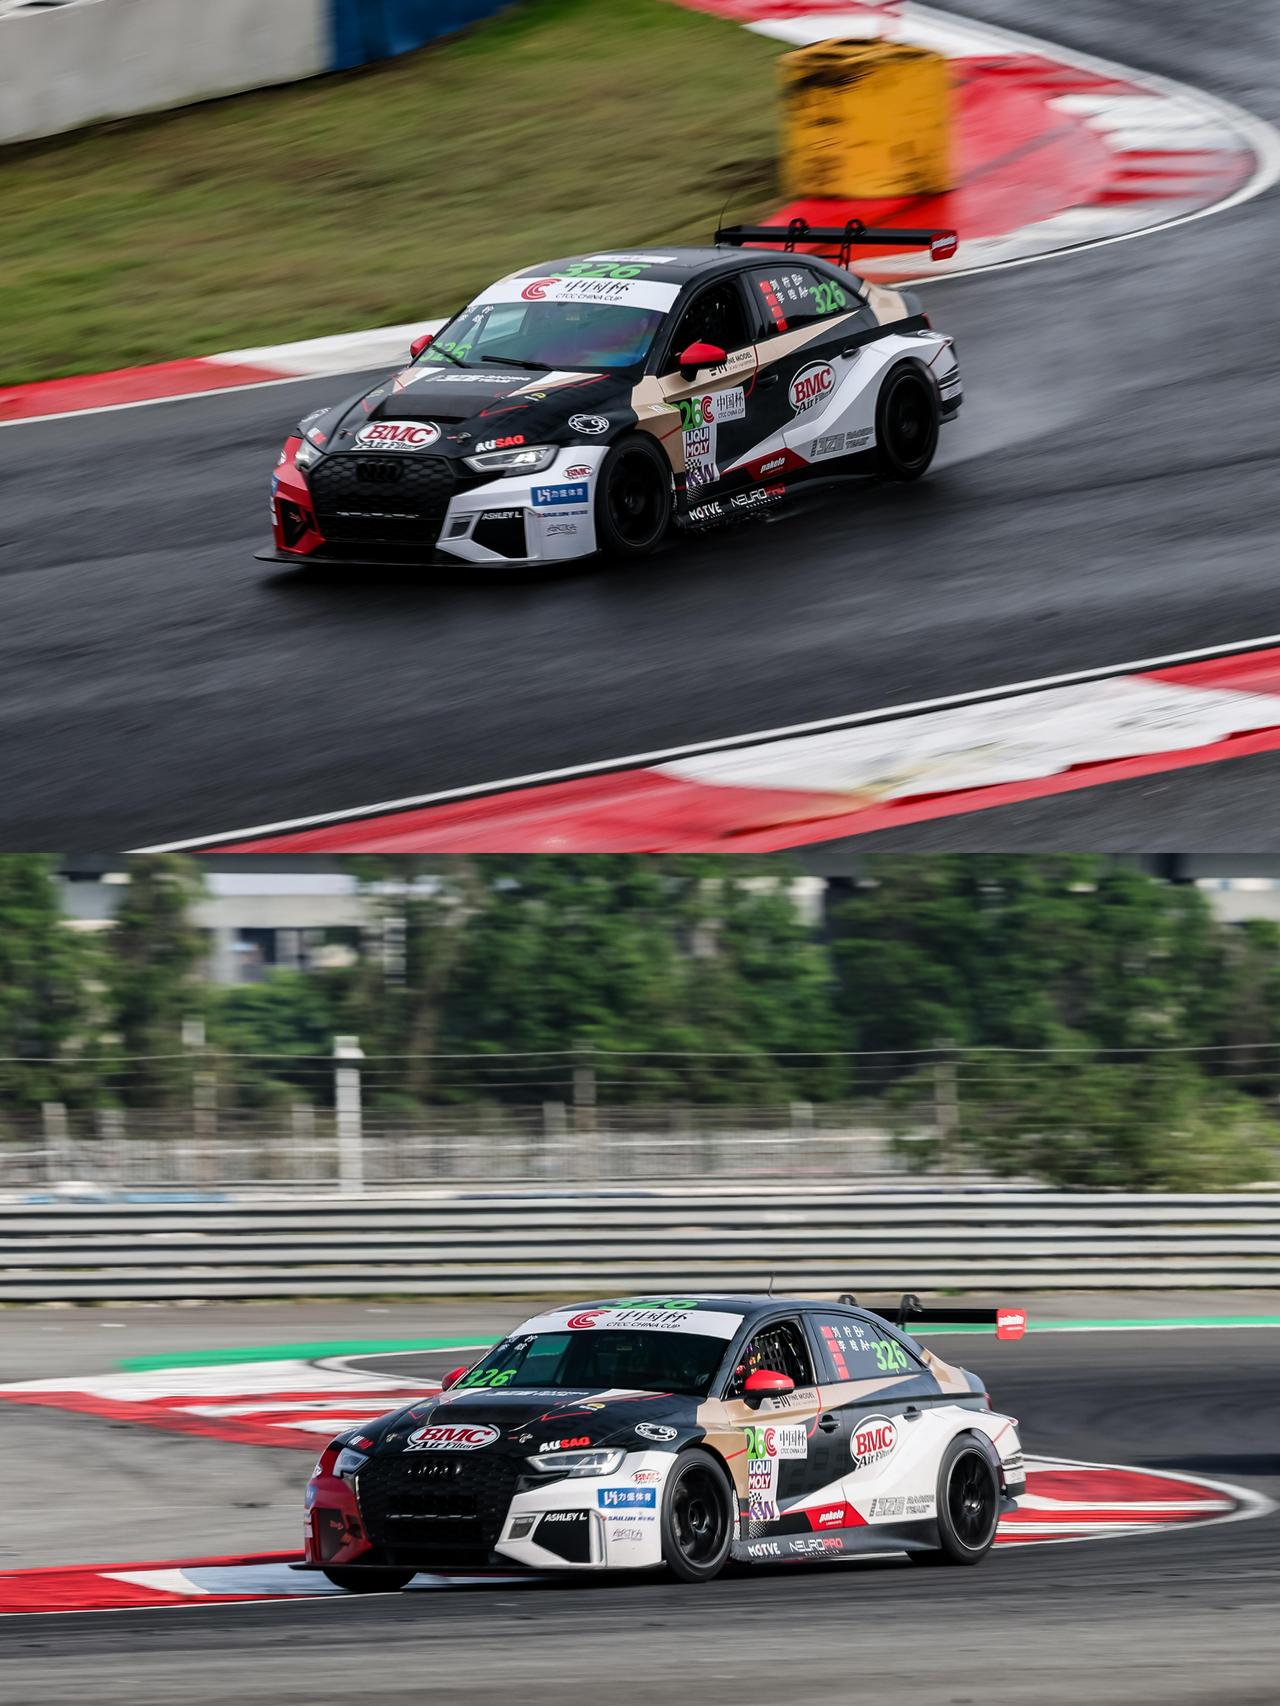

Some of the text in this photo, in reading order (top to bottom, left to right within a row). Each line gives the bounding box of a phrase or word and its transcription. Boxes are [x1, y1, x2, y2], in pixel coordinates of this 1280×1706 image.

[550, 262, 652, 279] 326
[809, 280, 847, 314] 326
[794, 368, 833, 405] BMC
[716, 391, 744, 411] 中国杯
[797, 397, 814, 416] Air
[361, 424, 433, 444] BMC
[686, 427, 710, 444] LIQUI
[686, 441, 710, 458] MOLY
[481, 511, 515, 521] ASHLEY
[870, 1339, 908, 1371] 326
[457, 1368, 518, 1389] 326
[417, 1428, 494, 1444] BMC
[779, 1429, 806, 1447] 中国杯
[855, 1425, 893, 1457] BMC
[410, 1440, 446, 1450] Air
[749, 1460, 771, 1474] LIQUI
[858, 1453, 875, 1469] Air
[748, 1474, 771, 1489] MOLY
[618, 1492, 651, 1502] 力盛体育
[544, 1512, 579, 1523] ASHLEY
[748, 1500, 775, 1521] KW
[819, 1509, 845, 1524] pakelo
